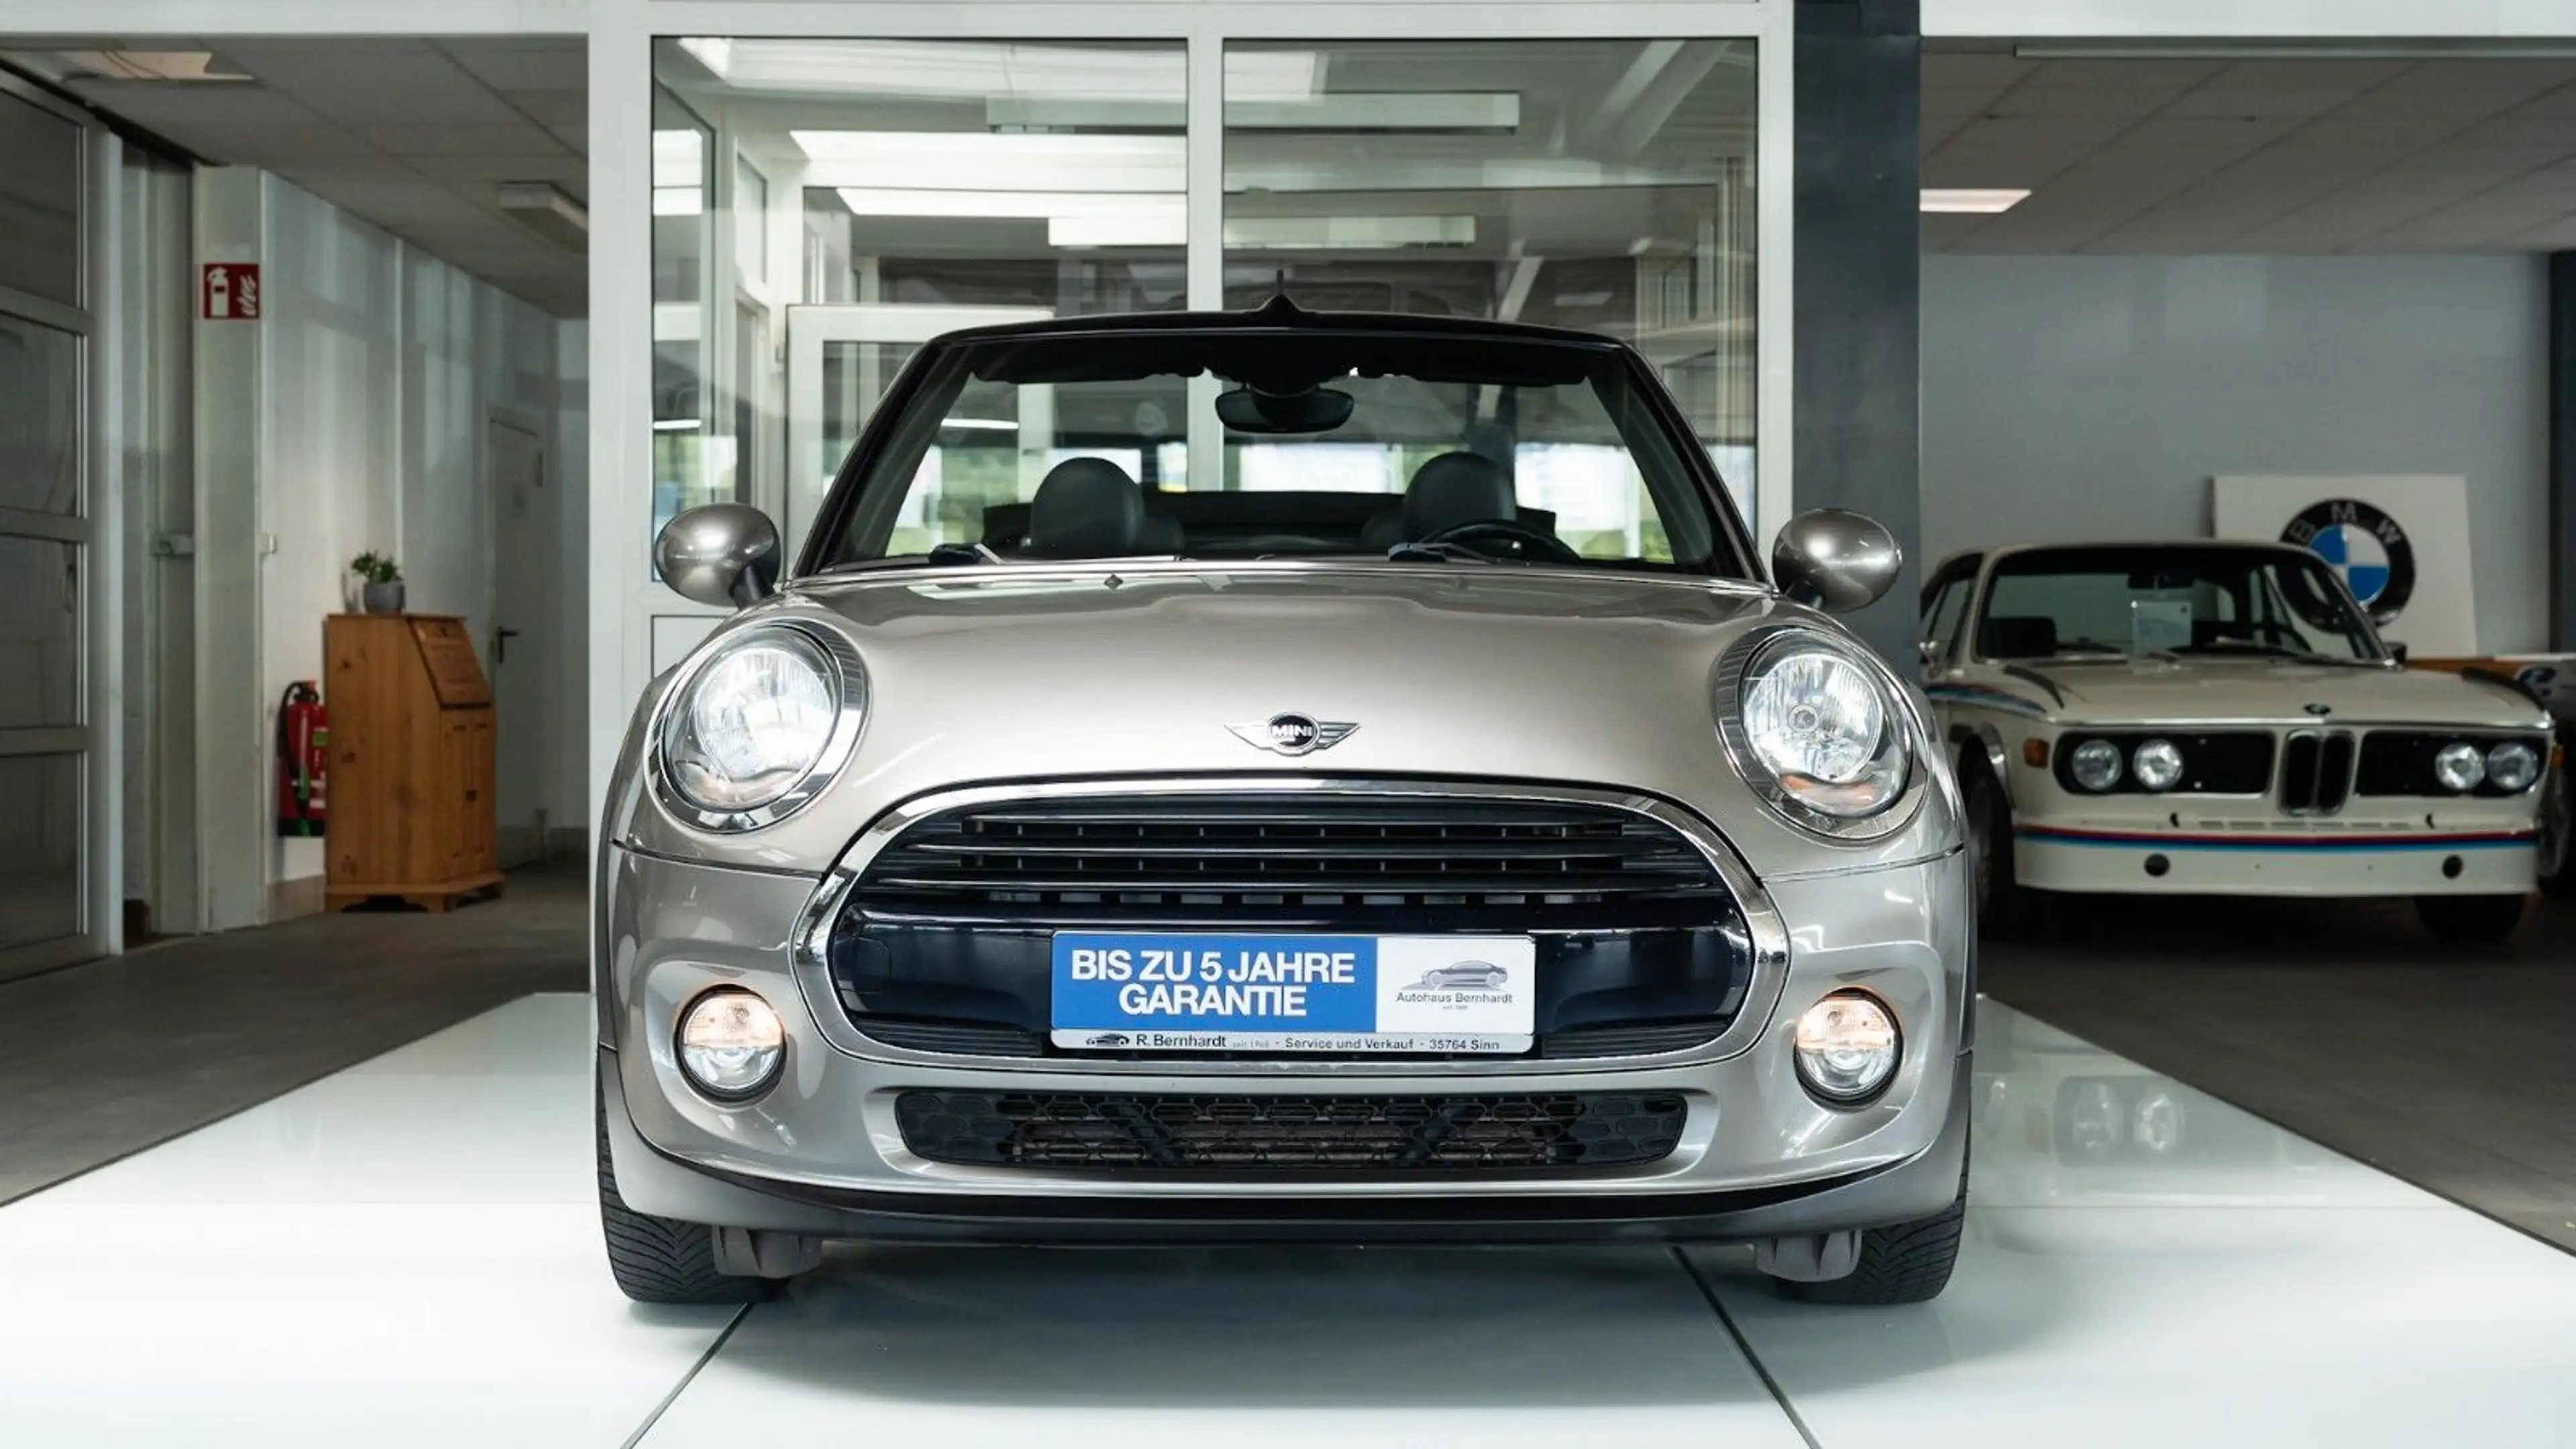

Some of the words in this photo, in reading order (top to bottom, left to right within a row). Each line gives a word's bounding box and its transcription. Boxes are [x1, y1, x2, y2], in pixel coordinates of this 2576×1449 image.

[1272, 724, 1312, 737] MINI
[1072, 949, 1132, 981] BIS
[1139, 951, 1193, 981] ZU
[1199, 951, 1222, 982] 5
[1228, 951, 1355, 983] JAHRE
[1119, 983, 1307, 1016] GARANTIE
[1395, 991, 1452, 1004] Autohaus
[1455, 991, 1513, 1004] Bernhardt
[1136, 1033, 1150, 1046] R.
[1153, 1034, 1226, 1048] Bernhardt
[1285, 1037, 1332, 1049] Service
[1337, 1038, 1361, 1049] und
[1364, 1038, 1413, 1050] Verkauf
[1430, 1039, 1466, 1050] 35764
[1470, 1040, 1500, 1051] Sinn
